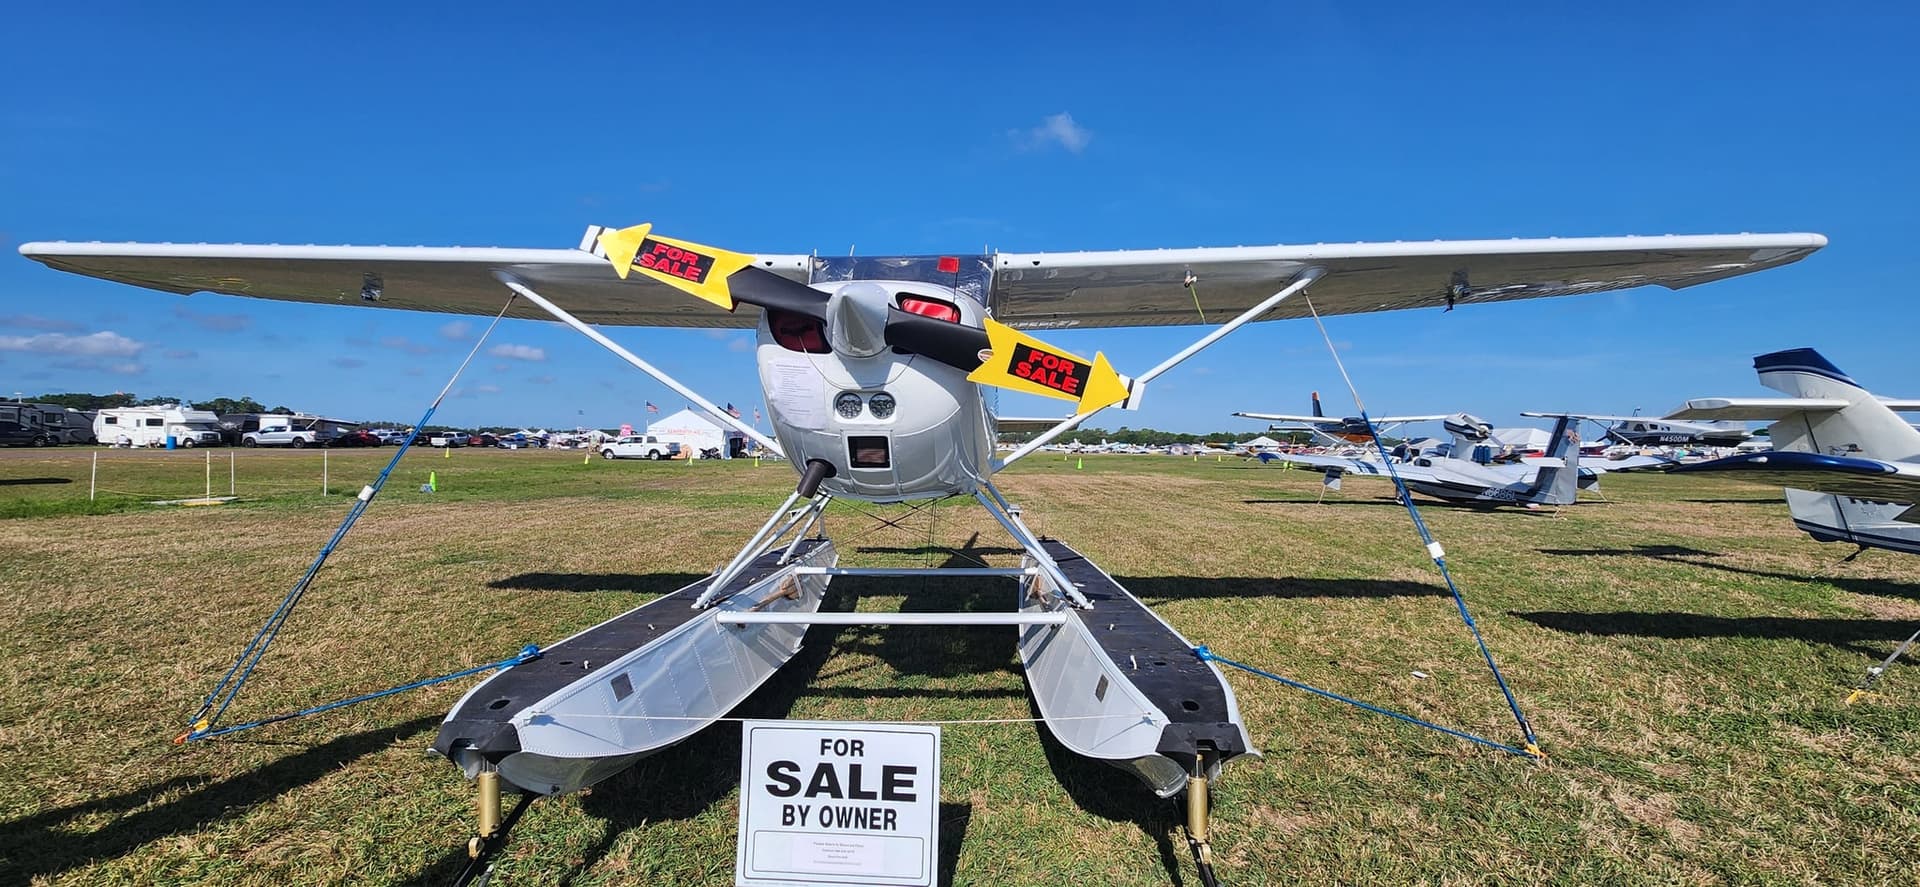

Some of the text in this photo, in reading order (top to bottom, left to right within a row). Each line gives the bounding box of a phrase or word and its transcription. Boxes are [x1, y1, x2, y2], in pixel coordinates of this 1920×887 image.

[640, 253, 702, 282] SALE
[652, 243, 699, 265] FOR
[1028, 349, 1075, 376] FOR
[1015, 361, 1080, 394] SALE
[820, 738, 865, 757] FOR
[765, 760, 918, 803] SALE
[782, 804, 898, 831] BY OWNER
